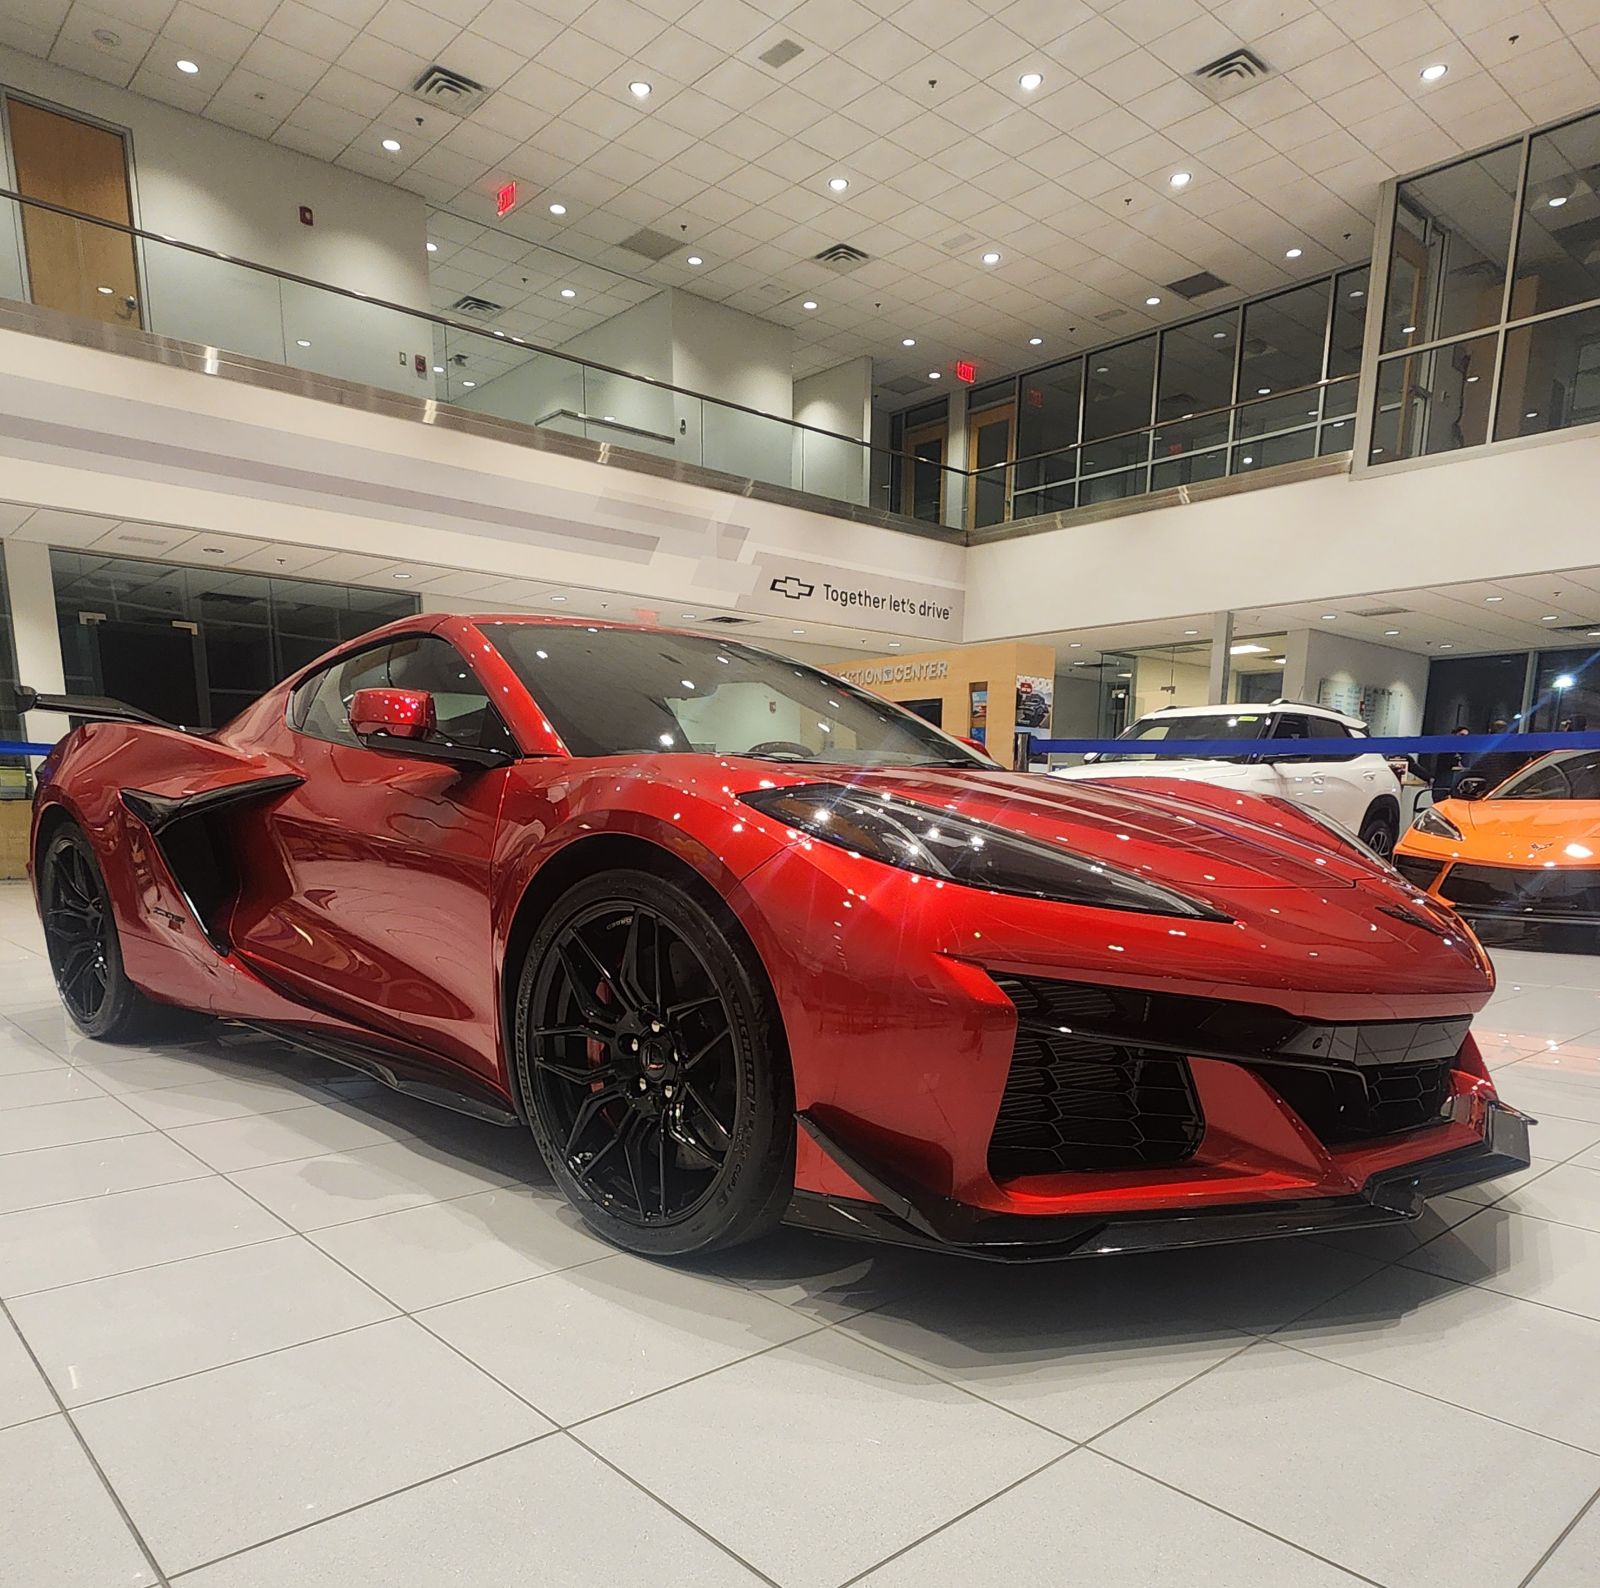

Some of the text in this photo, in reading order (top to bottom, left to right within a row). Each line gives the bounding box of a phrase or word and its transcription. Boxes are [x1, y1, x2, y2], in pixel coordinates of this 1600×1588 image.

[823, 583, 950, 620] Together let's drive
[894, 661, 949, 681] CENTER
[732, 1001, 756, 1097] MICHELIN
